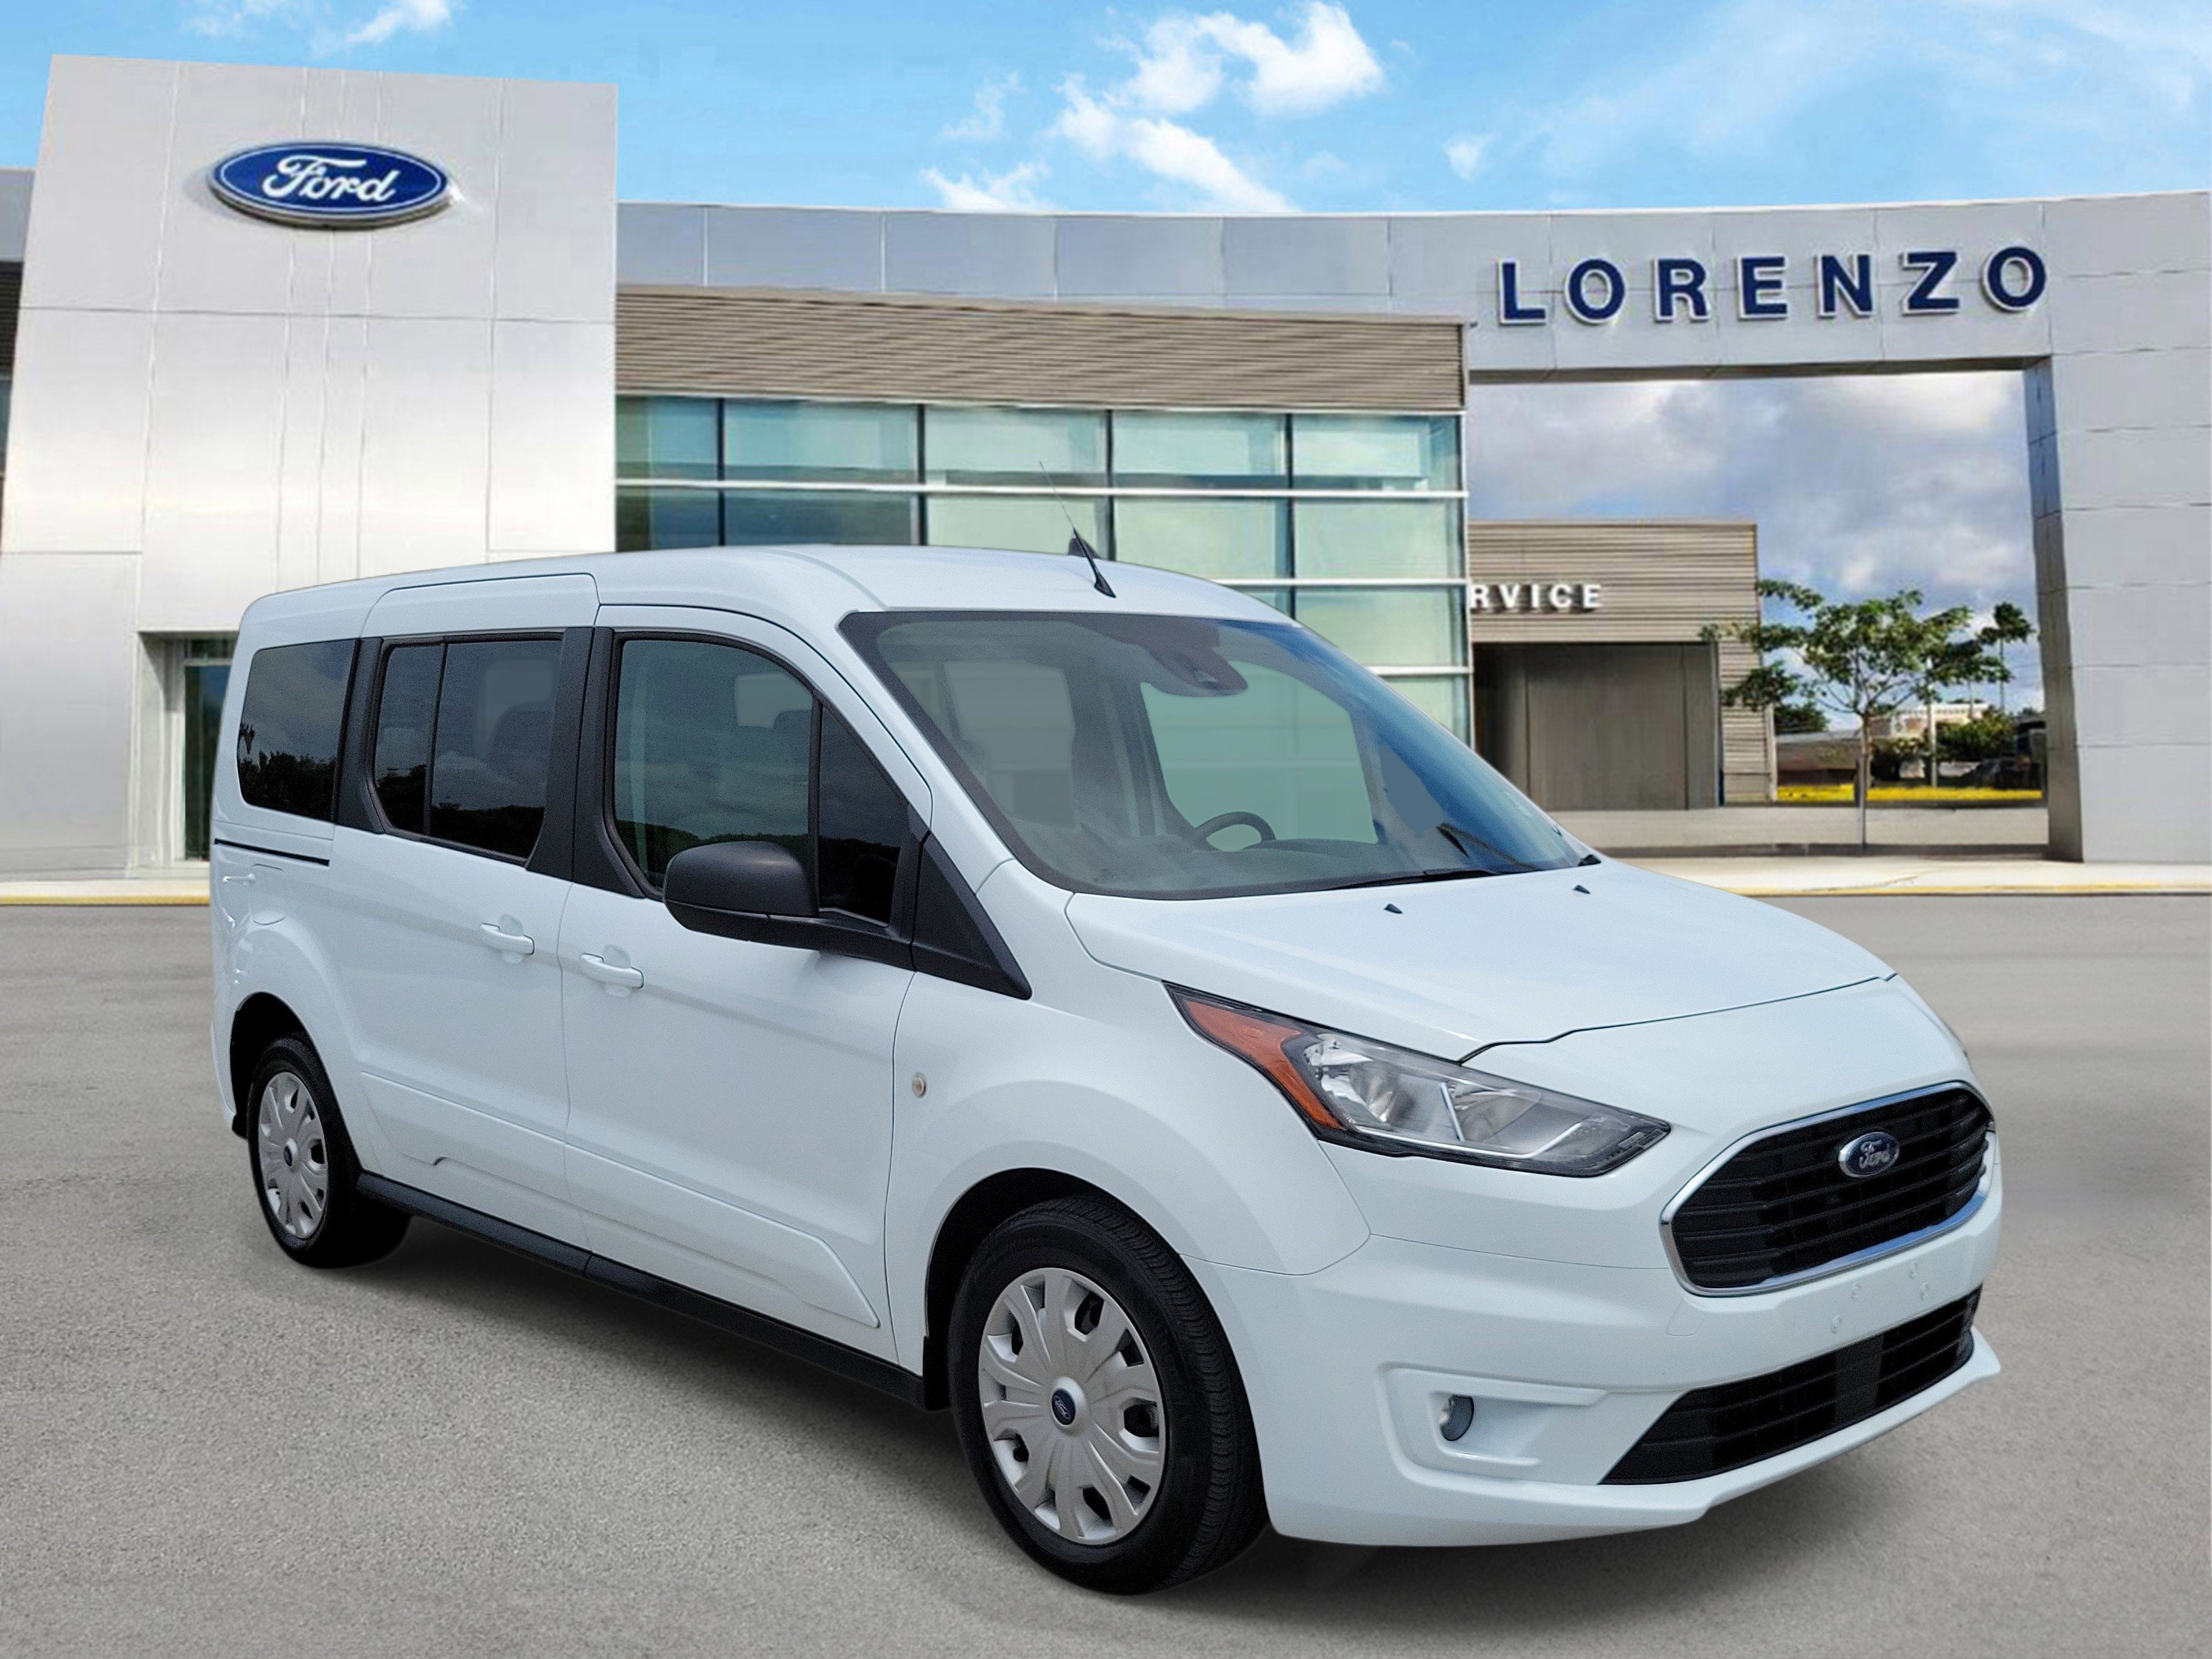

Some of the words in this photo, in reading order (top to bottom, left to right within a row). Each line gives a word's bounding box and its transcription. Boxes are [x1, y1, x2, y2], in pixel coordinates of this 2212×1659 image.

[262, 154, 400, 201] Ford
[1497, 247, 2047, 323] LORENZO
[1859, 1139, 1891, 1169] Ford
